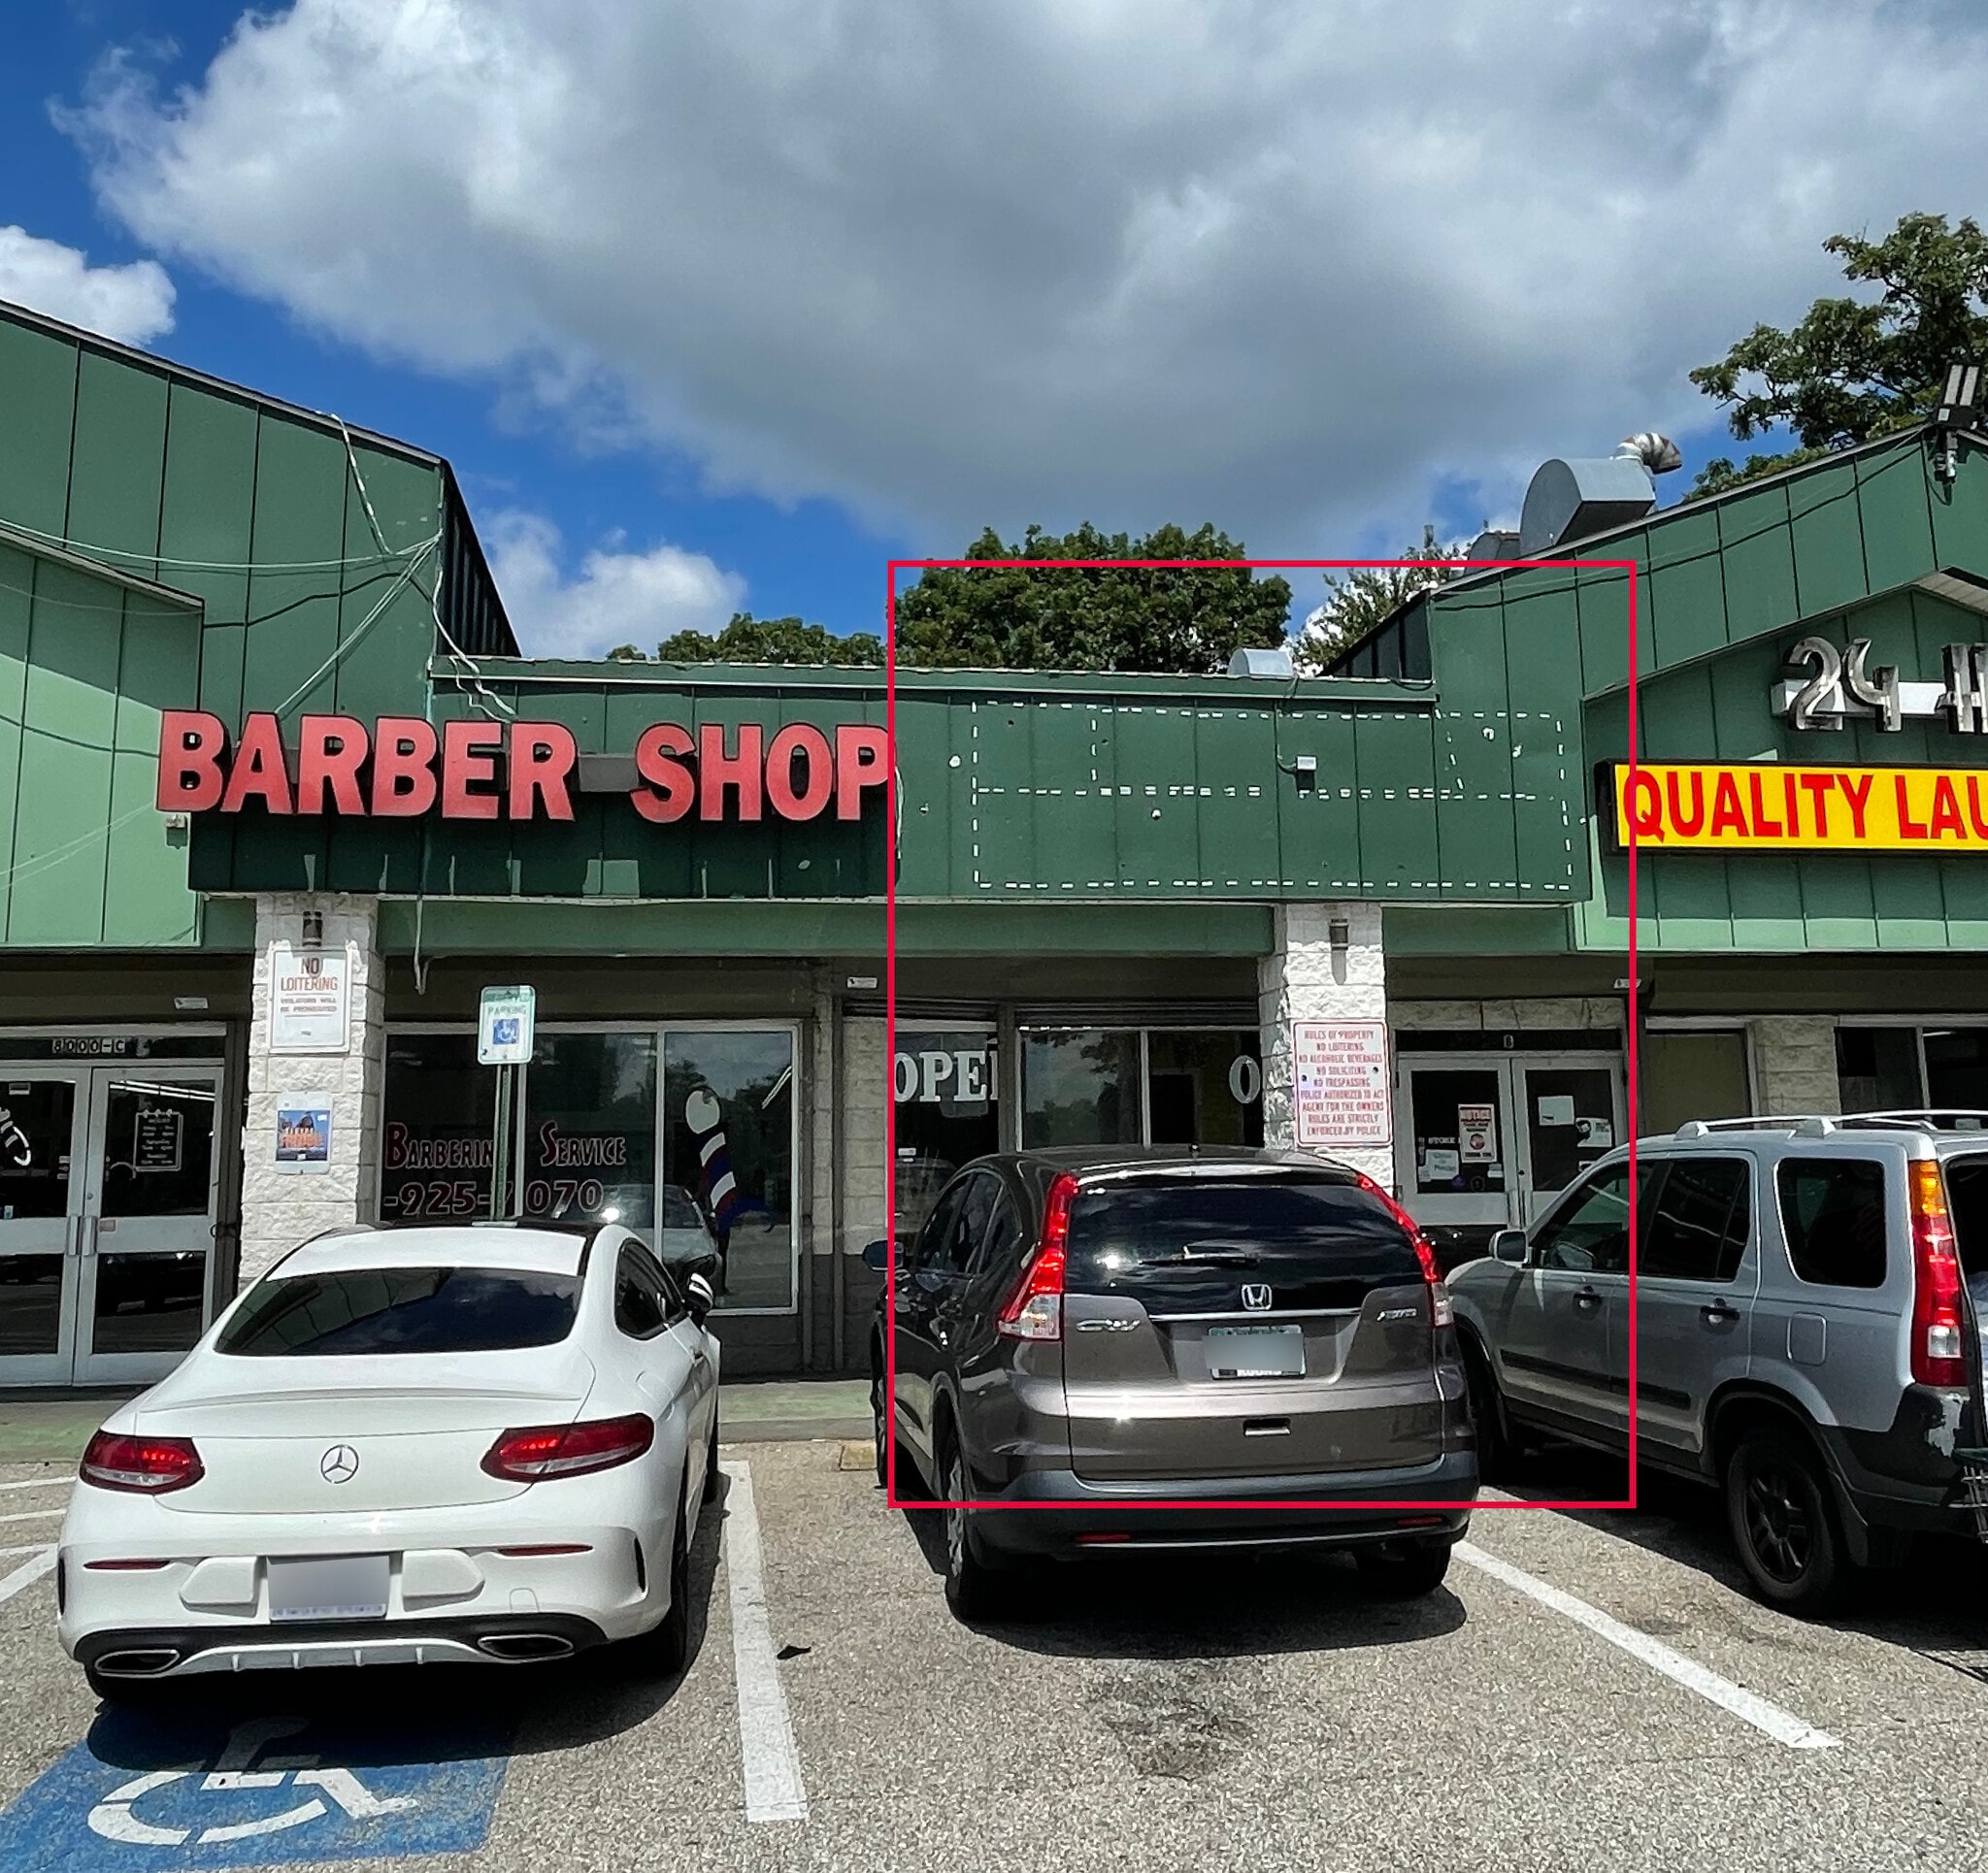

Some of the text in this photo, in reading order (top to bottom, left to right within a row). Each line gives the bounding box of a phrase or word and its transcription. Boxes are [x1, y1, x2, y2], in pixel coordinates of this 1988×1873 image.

[1784, 636, 1903, 732] 24
[156, 709, 896, 822] BARBER SHOP
[1624, 769, 1873, 843] QUALITY
[300, 957, 320, 974] NO
[281, 976, 338, 991] LOITERING
[53, 1039, 125, 1053] 8000-C
[1316, 1042, 1326, 1051] NO
[1299, 1054, 1308, 1063] NO
[384, 1120, 627, 1169] BARBERIN SERVICE
